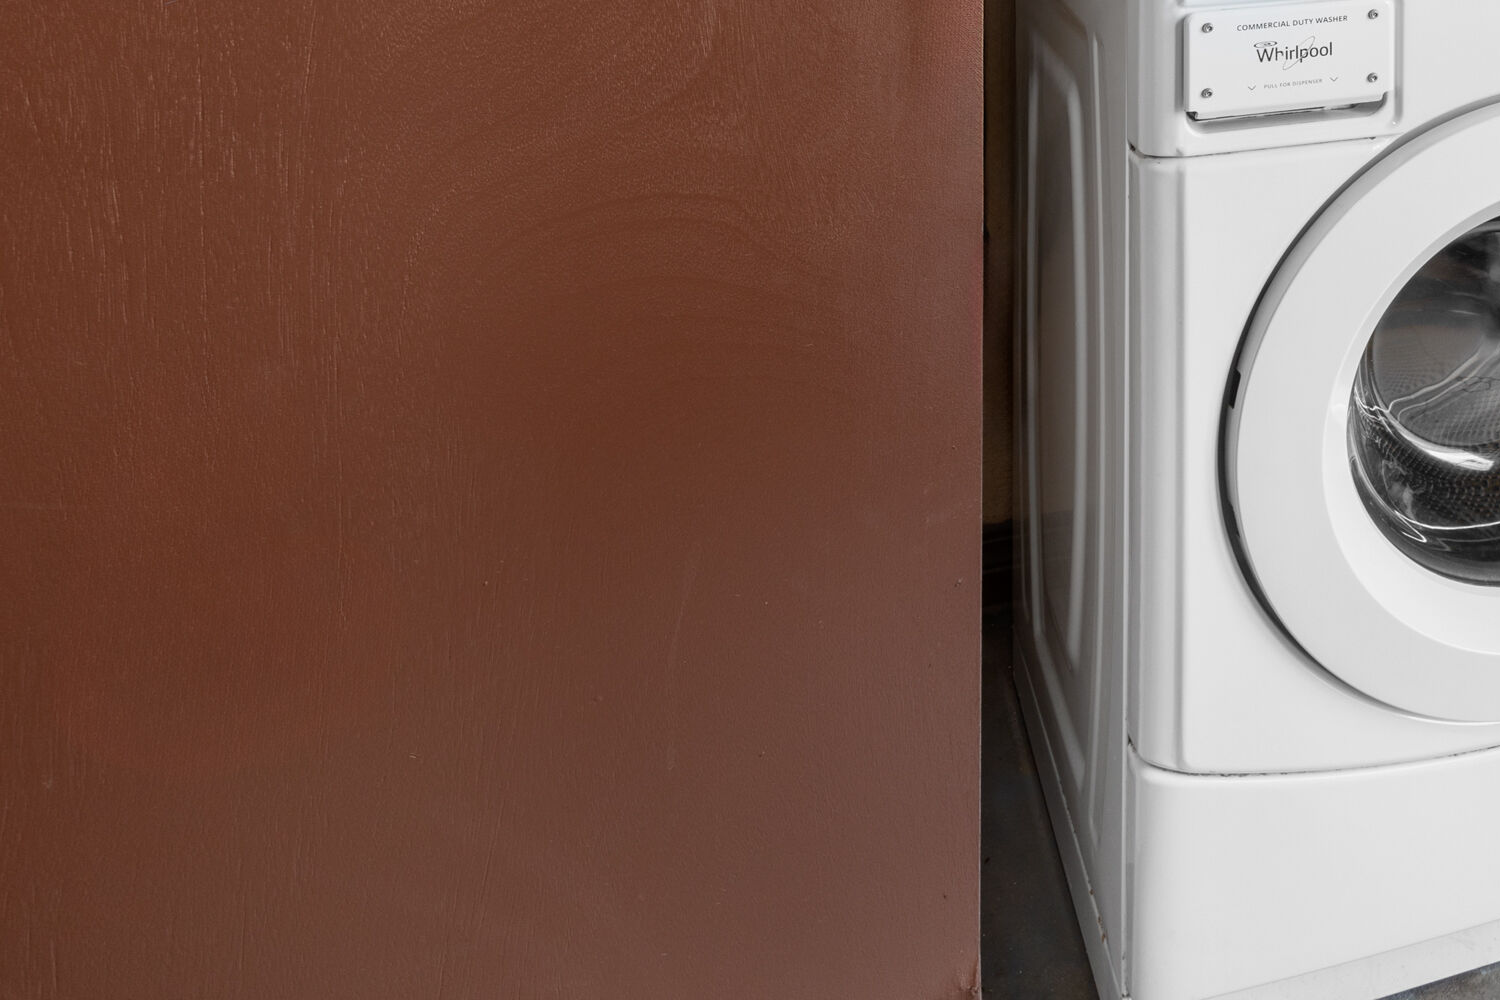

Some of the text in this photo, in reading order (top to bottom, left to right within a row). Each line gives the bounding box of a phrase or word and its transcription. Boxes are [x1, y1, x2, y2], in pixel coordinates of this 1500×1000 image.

[1236, 15, 1348, 32] COMMERCIAL DUTY WASHER
[1256, 41, 1333, 63] Whirlpool
[1292, 78, 1323, 86] DISPENSER
